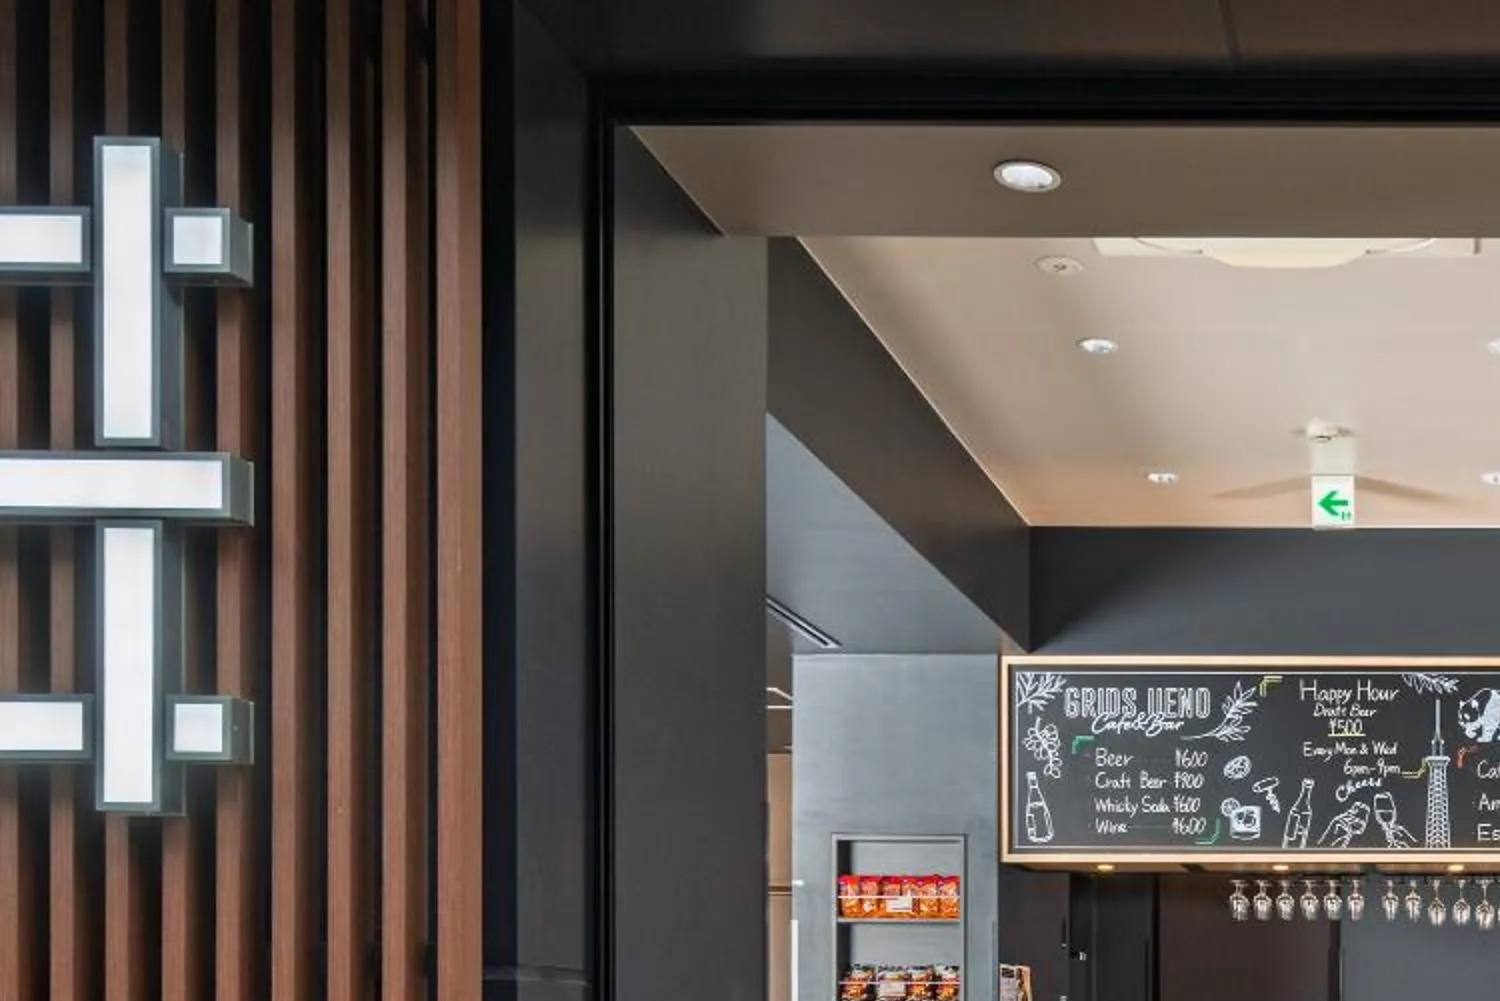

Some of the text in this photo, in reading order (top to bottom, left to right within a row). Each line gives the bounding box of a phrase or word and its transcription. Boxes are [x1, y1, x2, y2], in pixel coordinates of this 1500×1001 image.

[1300, 678, 1400, 704] Happy Hour
[1064, 687, 1211, 718] GRIDS UENO
[1313, 702, 1377, 717] Draft Beer
[1334, 741, 1357, 755] Mon
[1359, 742, 1369, 755] &
[1371, 740, 1399, 755] Wed
[1095, 747, 1135, 767] Beer
[1095, 771, 1131, 789] Craft
[1140, 770, 1167, 789] Beer
[1141, 795, 1171, 813] Soda
[1095, 818, 1129, 834] Wine
